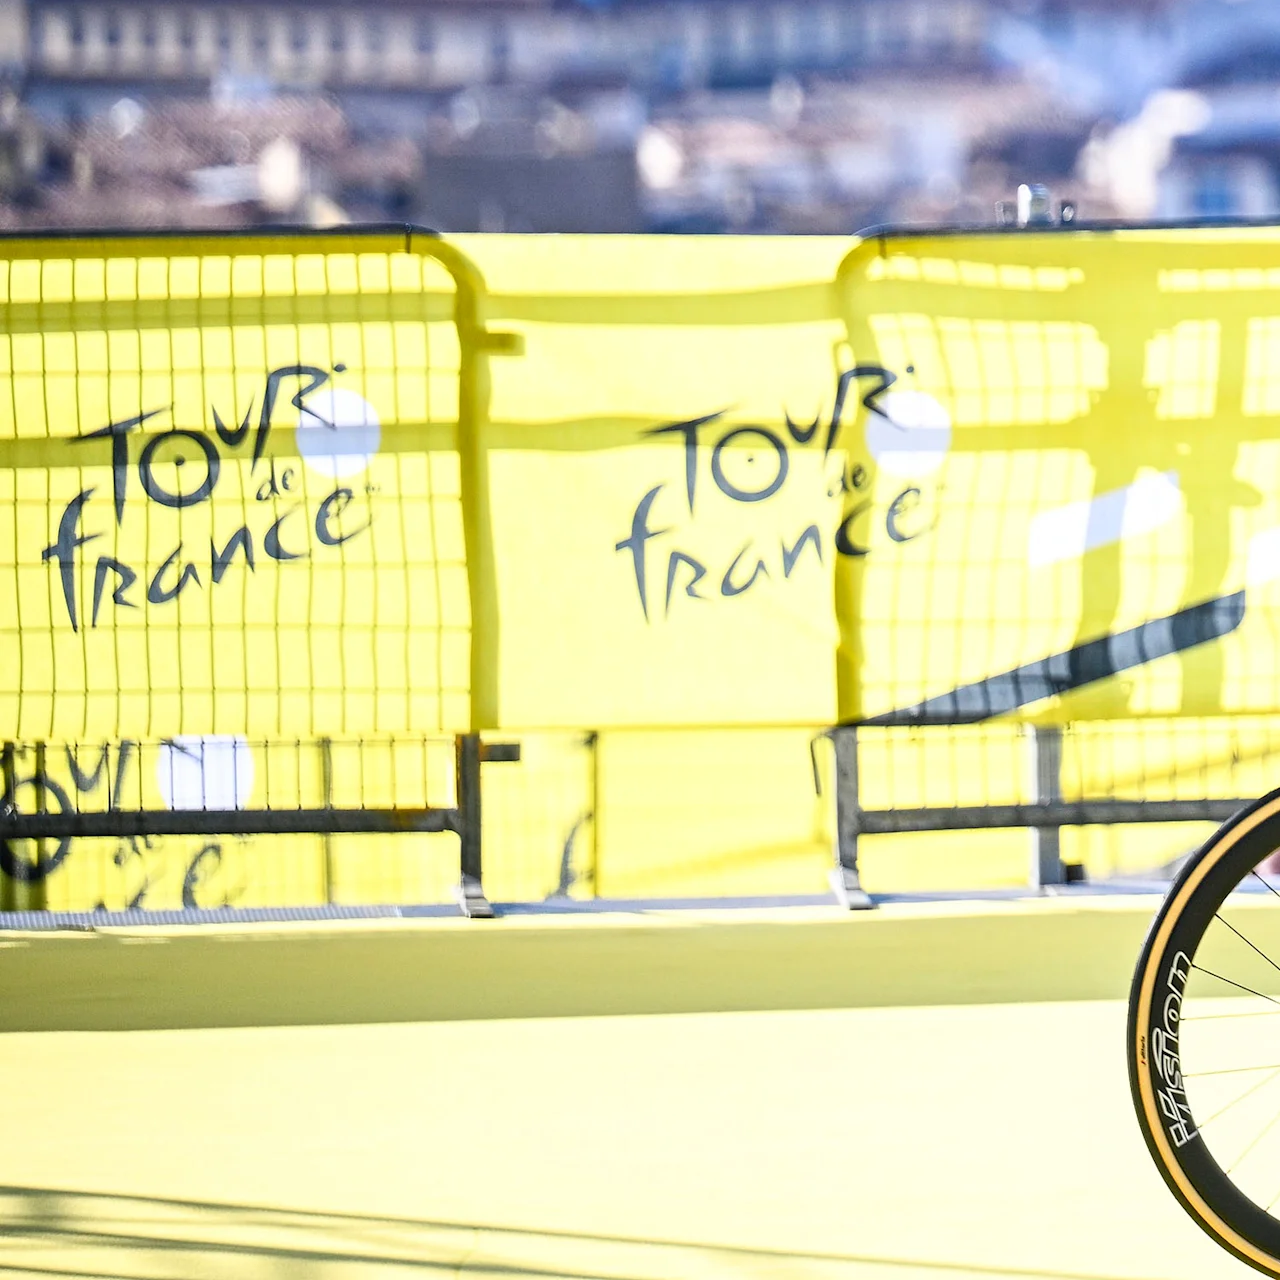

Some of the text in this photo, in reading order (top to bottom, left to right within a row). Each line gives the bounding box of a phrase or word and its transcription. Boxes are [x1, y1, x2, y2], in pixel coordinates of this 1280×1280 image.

[67, 362, 346, 527] TOUR
[256, 453, 297, 503] de
[640, 363, 916, 516] TOUR
[827, 460, 870, 498] de
[42, 486, 374, 632] france
[615, 483, 938, 624] france
